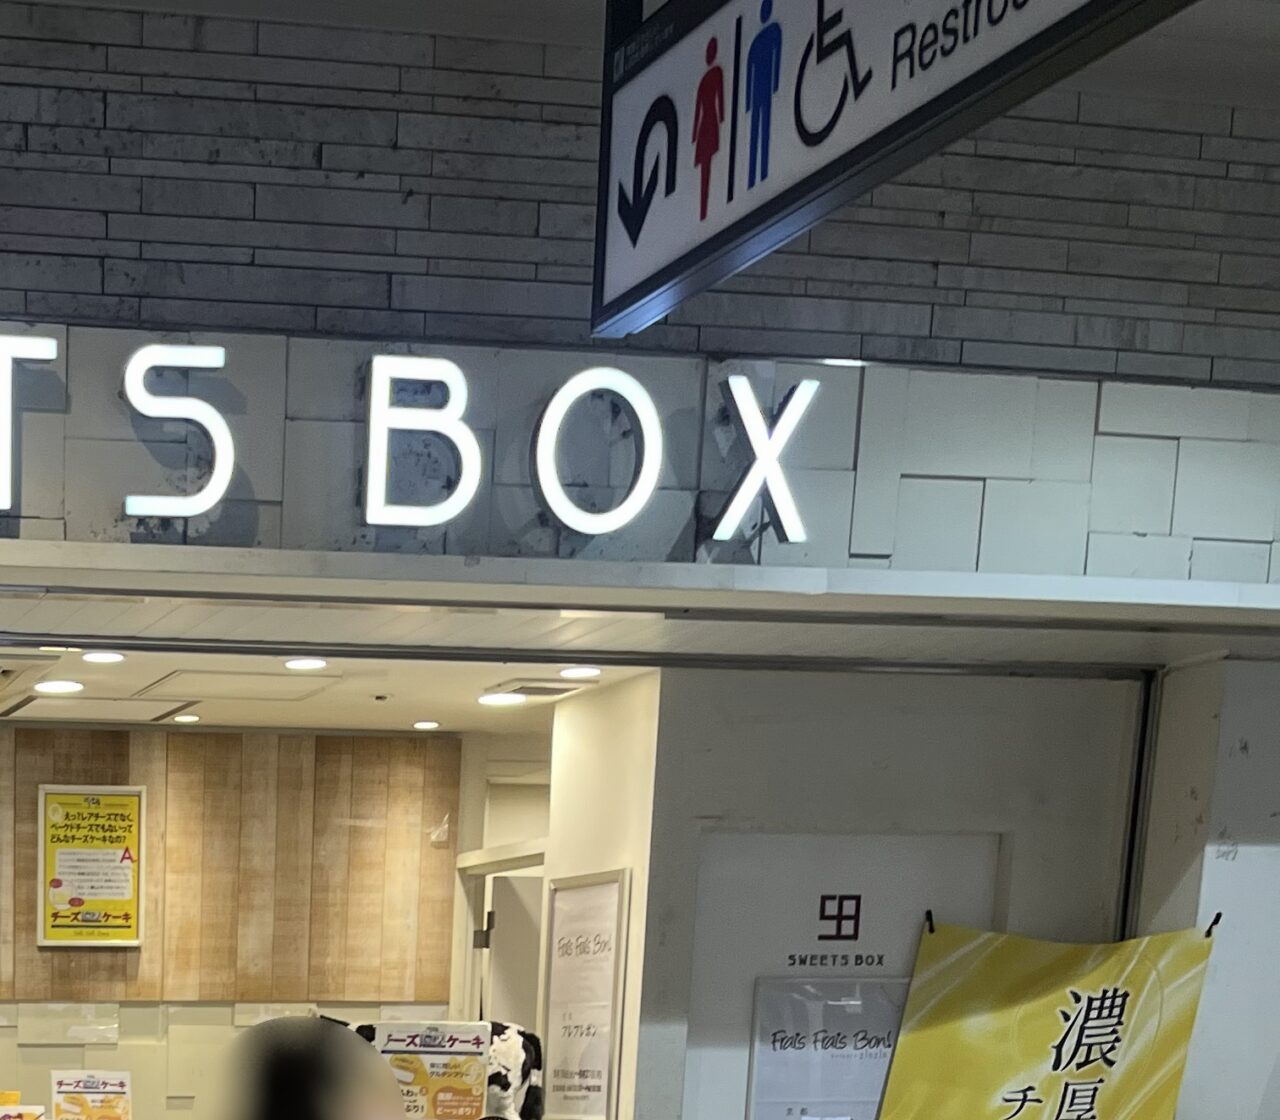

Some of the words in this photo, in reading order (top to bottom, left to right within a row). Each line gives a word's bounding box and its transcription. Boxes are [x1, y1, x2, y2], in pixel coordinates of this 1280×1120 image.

[891, 0, 1029, 91] Restro
[365, 354, 821, 543] BOX
[788, 954, 849, 966] SWEETS
[854, 954, 885, 966] BOX
[771, 1029, 807, 1052] Frais
[813, 1029, 847, 1051] Frais
[853, 1029, 893, 1051] Bon!
